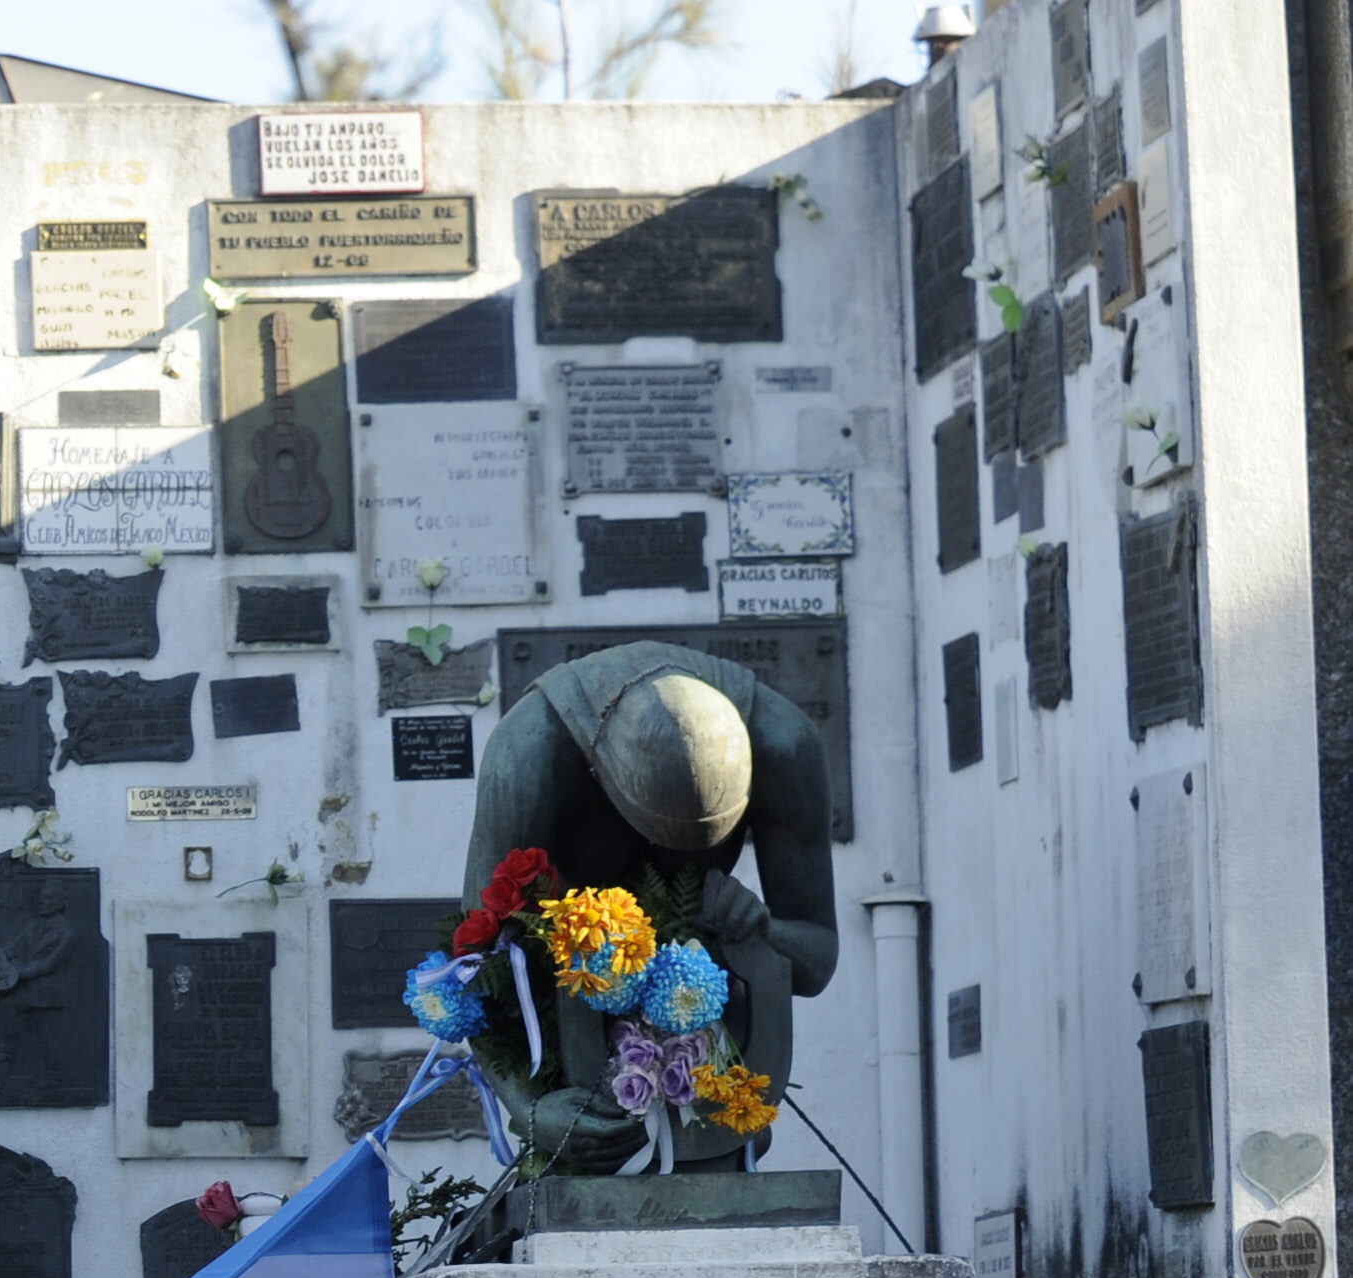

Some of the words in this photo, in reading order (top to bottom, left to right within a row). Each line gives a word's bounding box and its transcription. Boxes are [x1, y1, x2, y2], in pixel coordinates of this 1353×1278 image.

[305, 123, 322, 136] TU
[327, 140, 354, 151] LOS
[265, 156, 283, 169] SE
[340, 155, 355, 167] EL
[360, 154, 406, 166] DOLOR
[222, 211, 258, 224] CON
[721, 569, 776, 582] GRACIAS
[738, 597, 823, 612] REYNALDO
[139, 789, 191, 800] GRACIAS
[194, 787, 243, 799] CARLOS
